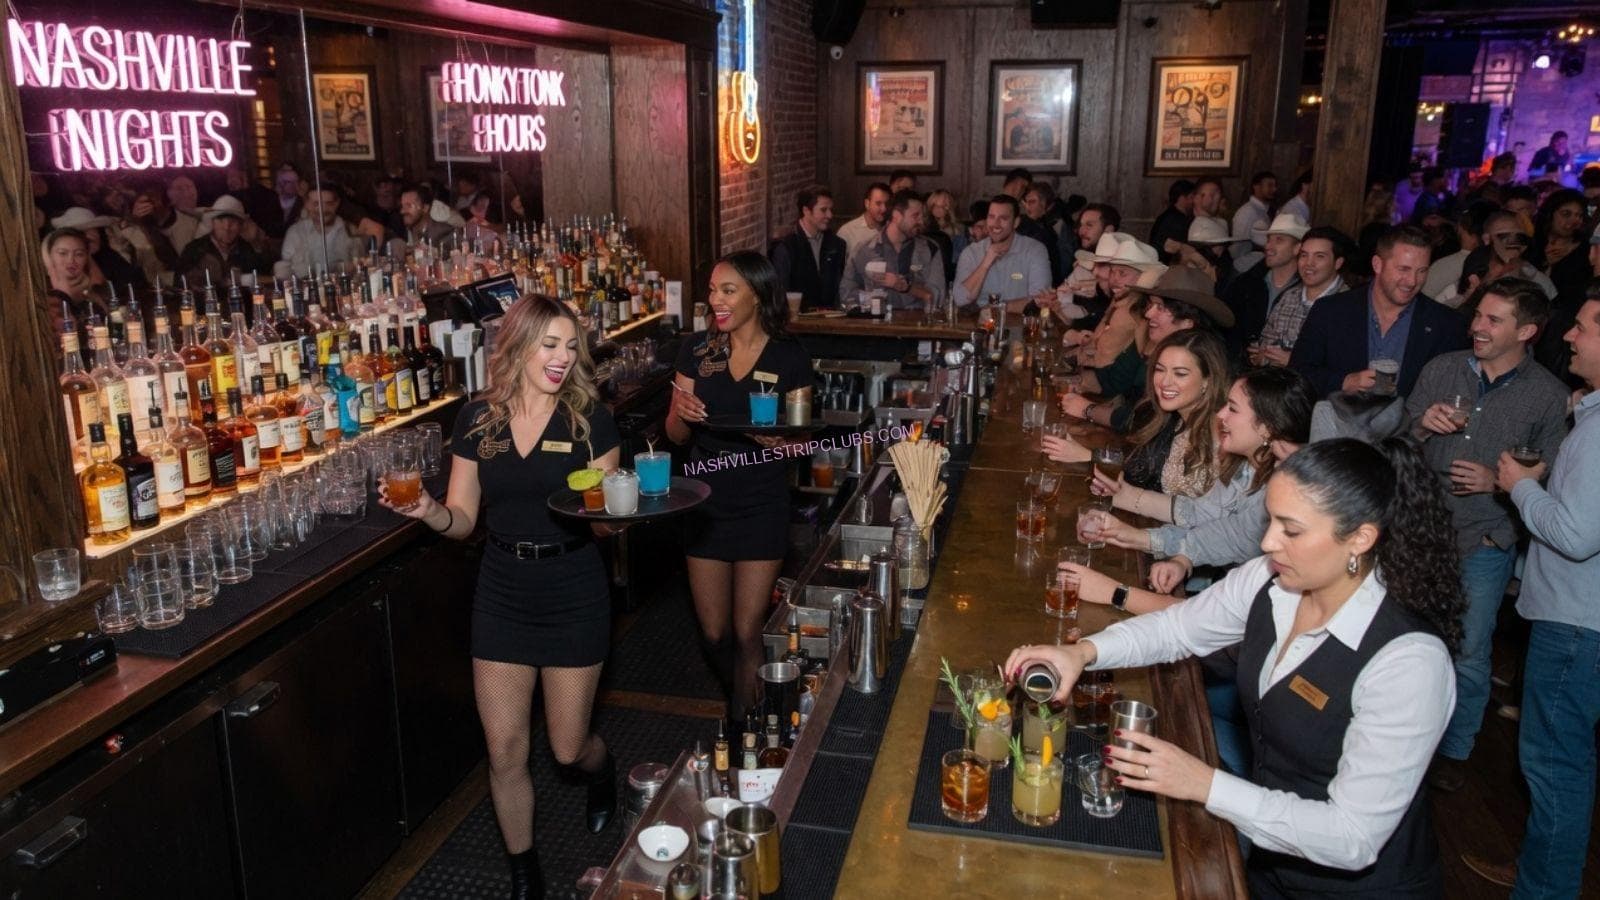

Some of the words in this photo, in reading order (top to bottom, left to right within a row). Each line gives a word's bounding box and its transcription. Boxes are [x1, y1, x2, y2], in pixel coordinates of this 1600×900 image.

[7, 18, 257, 96] NASHVILLE
[65, 108, 233, 172] NIGHTS
[486, 113, 547, 152] HOURS
